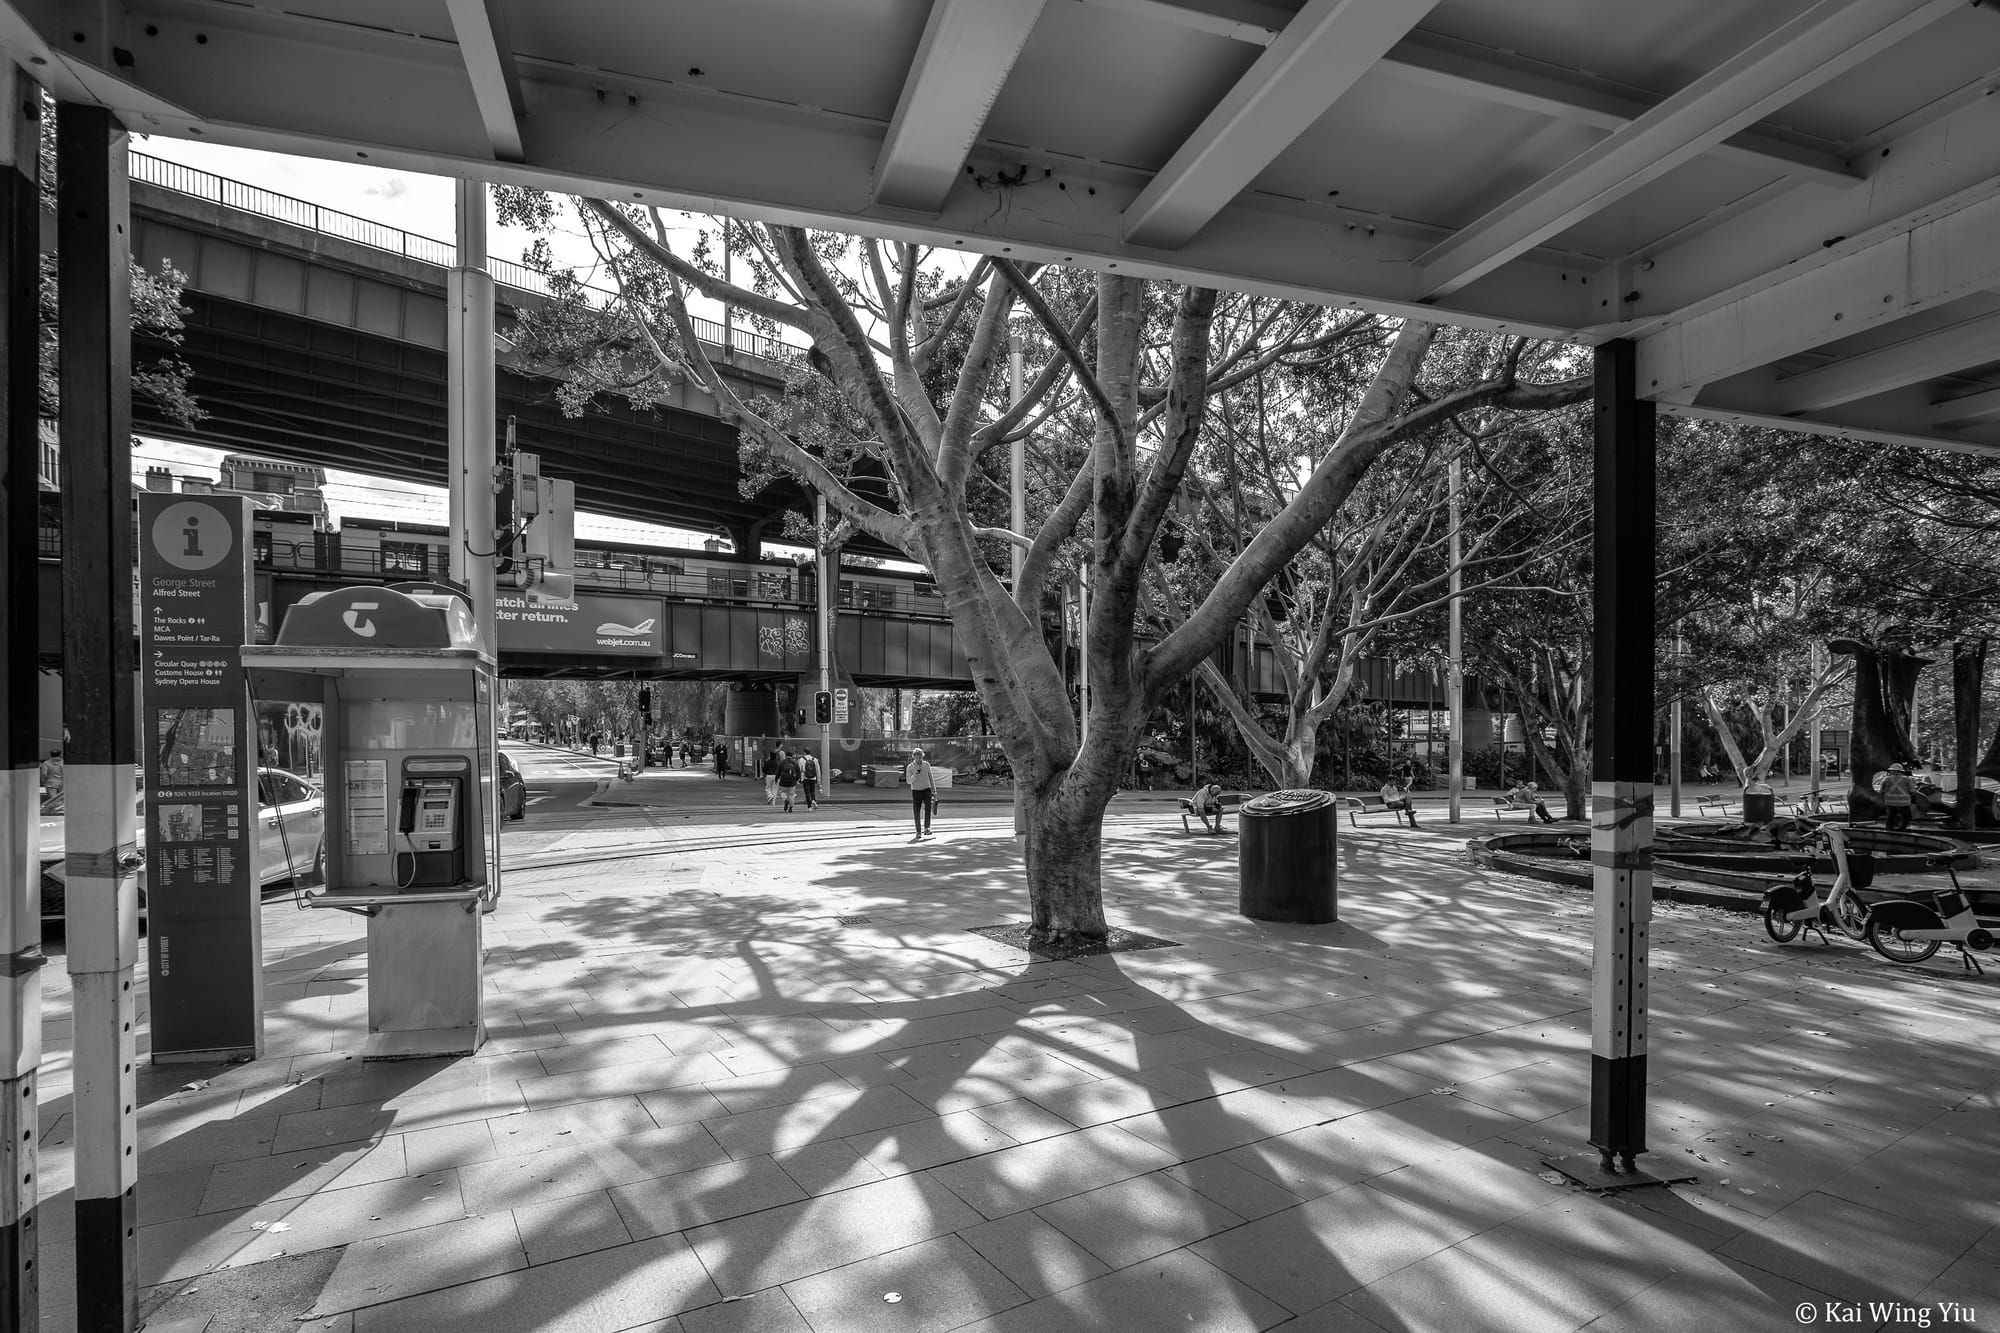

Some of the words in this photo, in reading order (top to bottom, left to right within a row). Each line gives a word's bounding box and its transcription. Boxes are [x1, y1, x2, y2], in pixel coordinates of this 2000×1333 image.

[152, 577, 187, 589] George
[189, 578, 216, 588] Street
[152, 589, 176, 597] Alfred
[178, 589, 201, 598] Street
[521, 611, 569, 623] return.
[596, 638, 651, 647] webjet.com.au
[180, 660, 198, 668] Quay
[154, 678, 178, 686] Sydney
[179, 678, 199, 686] Opera
